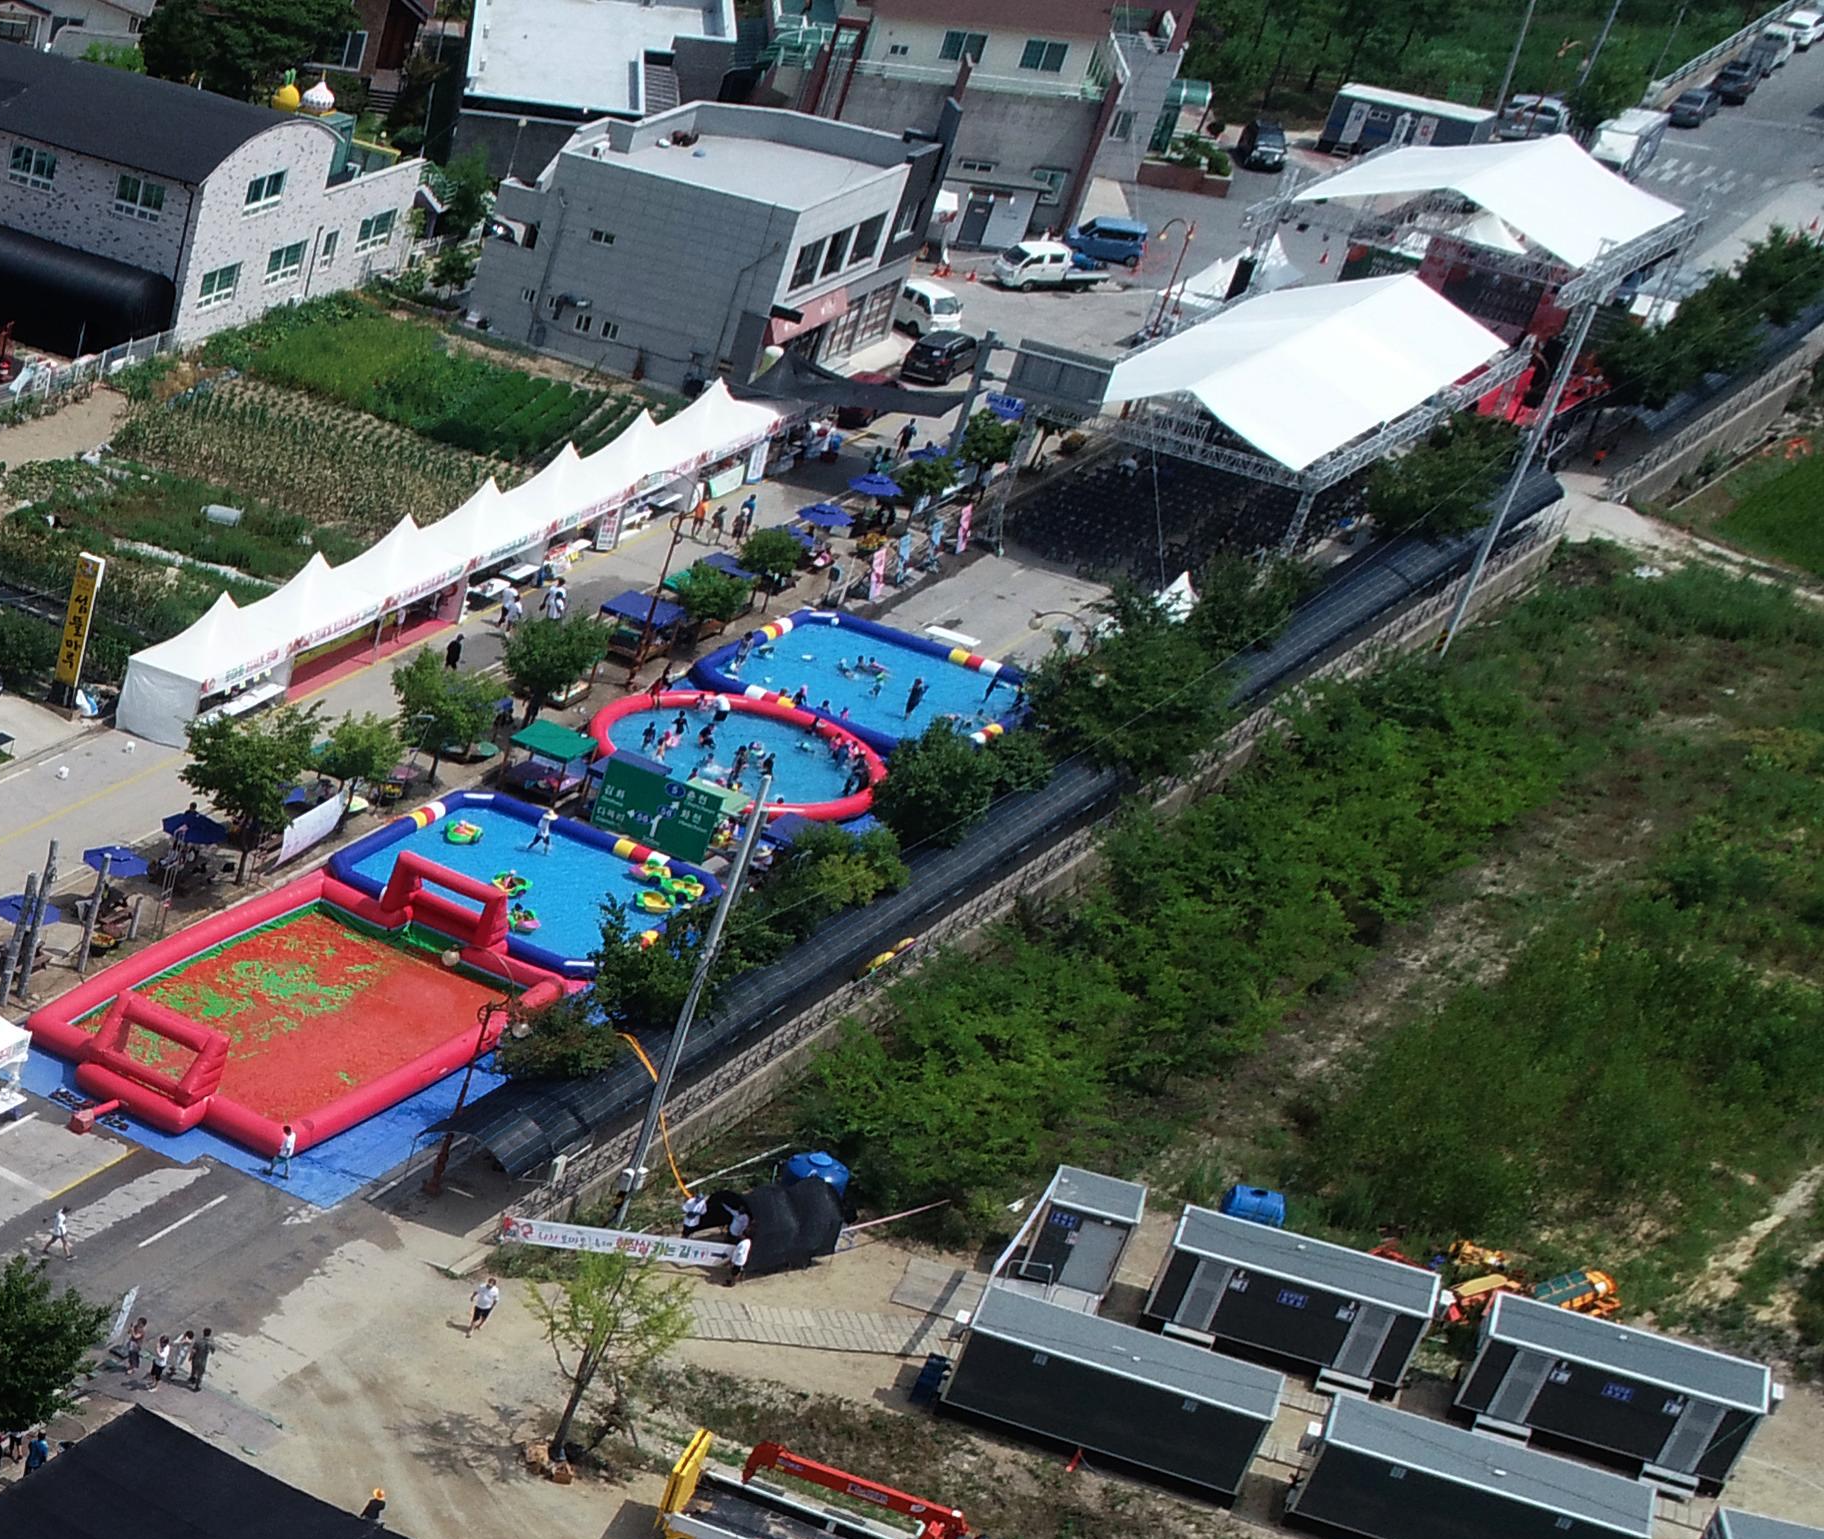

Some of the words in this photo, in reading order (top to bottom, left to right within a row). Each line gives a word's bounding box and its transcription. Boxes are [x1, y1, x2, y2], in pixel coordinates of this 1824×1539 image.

[615, 1235, 650, 1255] 화장실
[653, 1240, 677, 1257] 가는
[679, 1244, 692, 1260] 길
